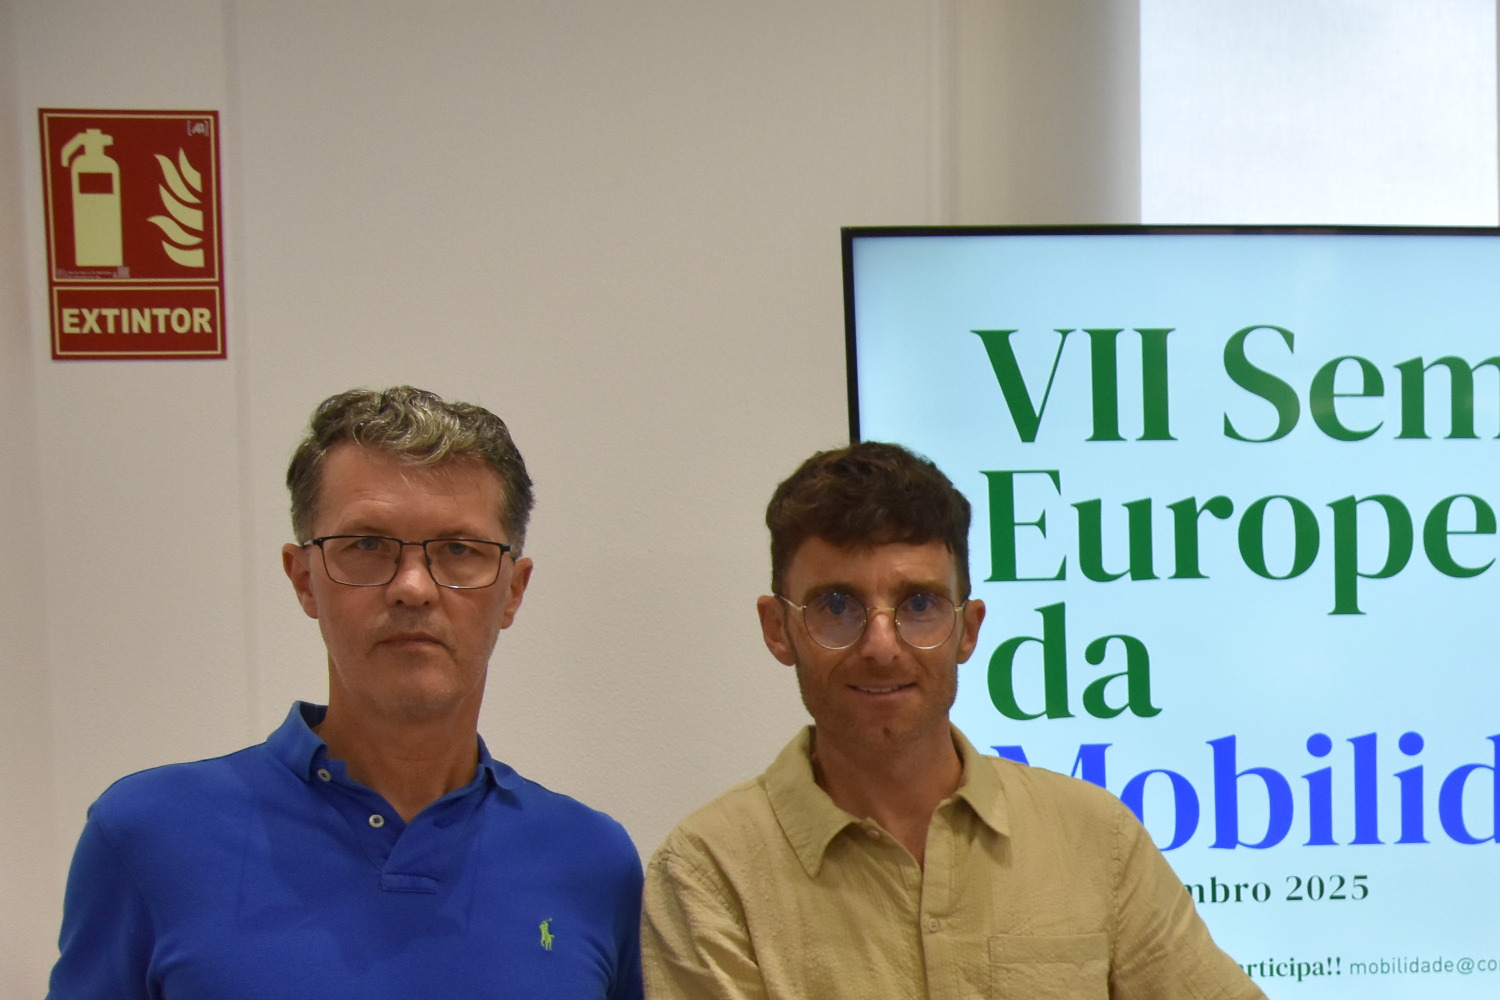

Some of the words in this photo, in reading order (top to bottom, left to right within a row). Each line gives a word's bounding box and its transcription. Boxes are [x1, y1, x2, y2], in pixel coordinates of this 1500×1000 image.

[61, 307, 213, 334] EXTINTOR
[969, 326, 1178, 443] VII
[986, 602, 1162, 722] da
[1286, 874, 1369, 901] 2025
[1240, 957, 1341, 982] rticipa!!
